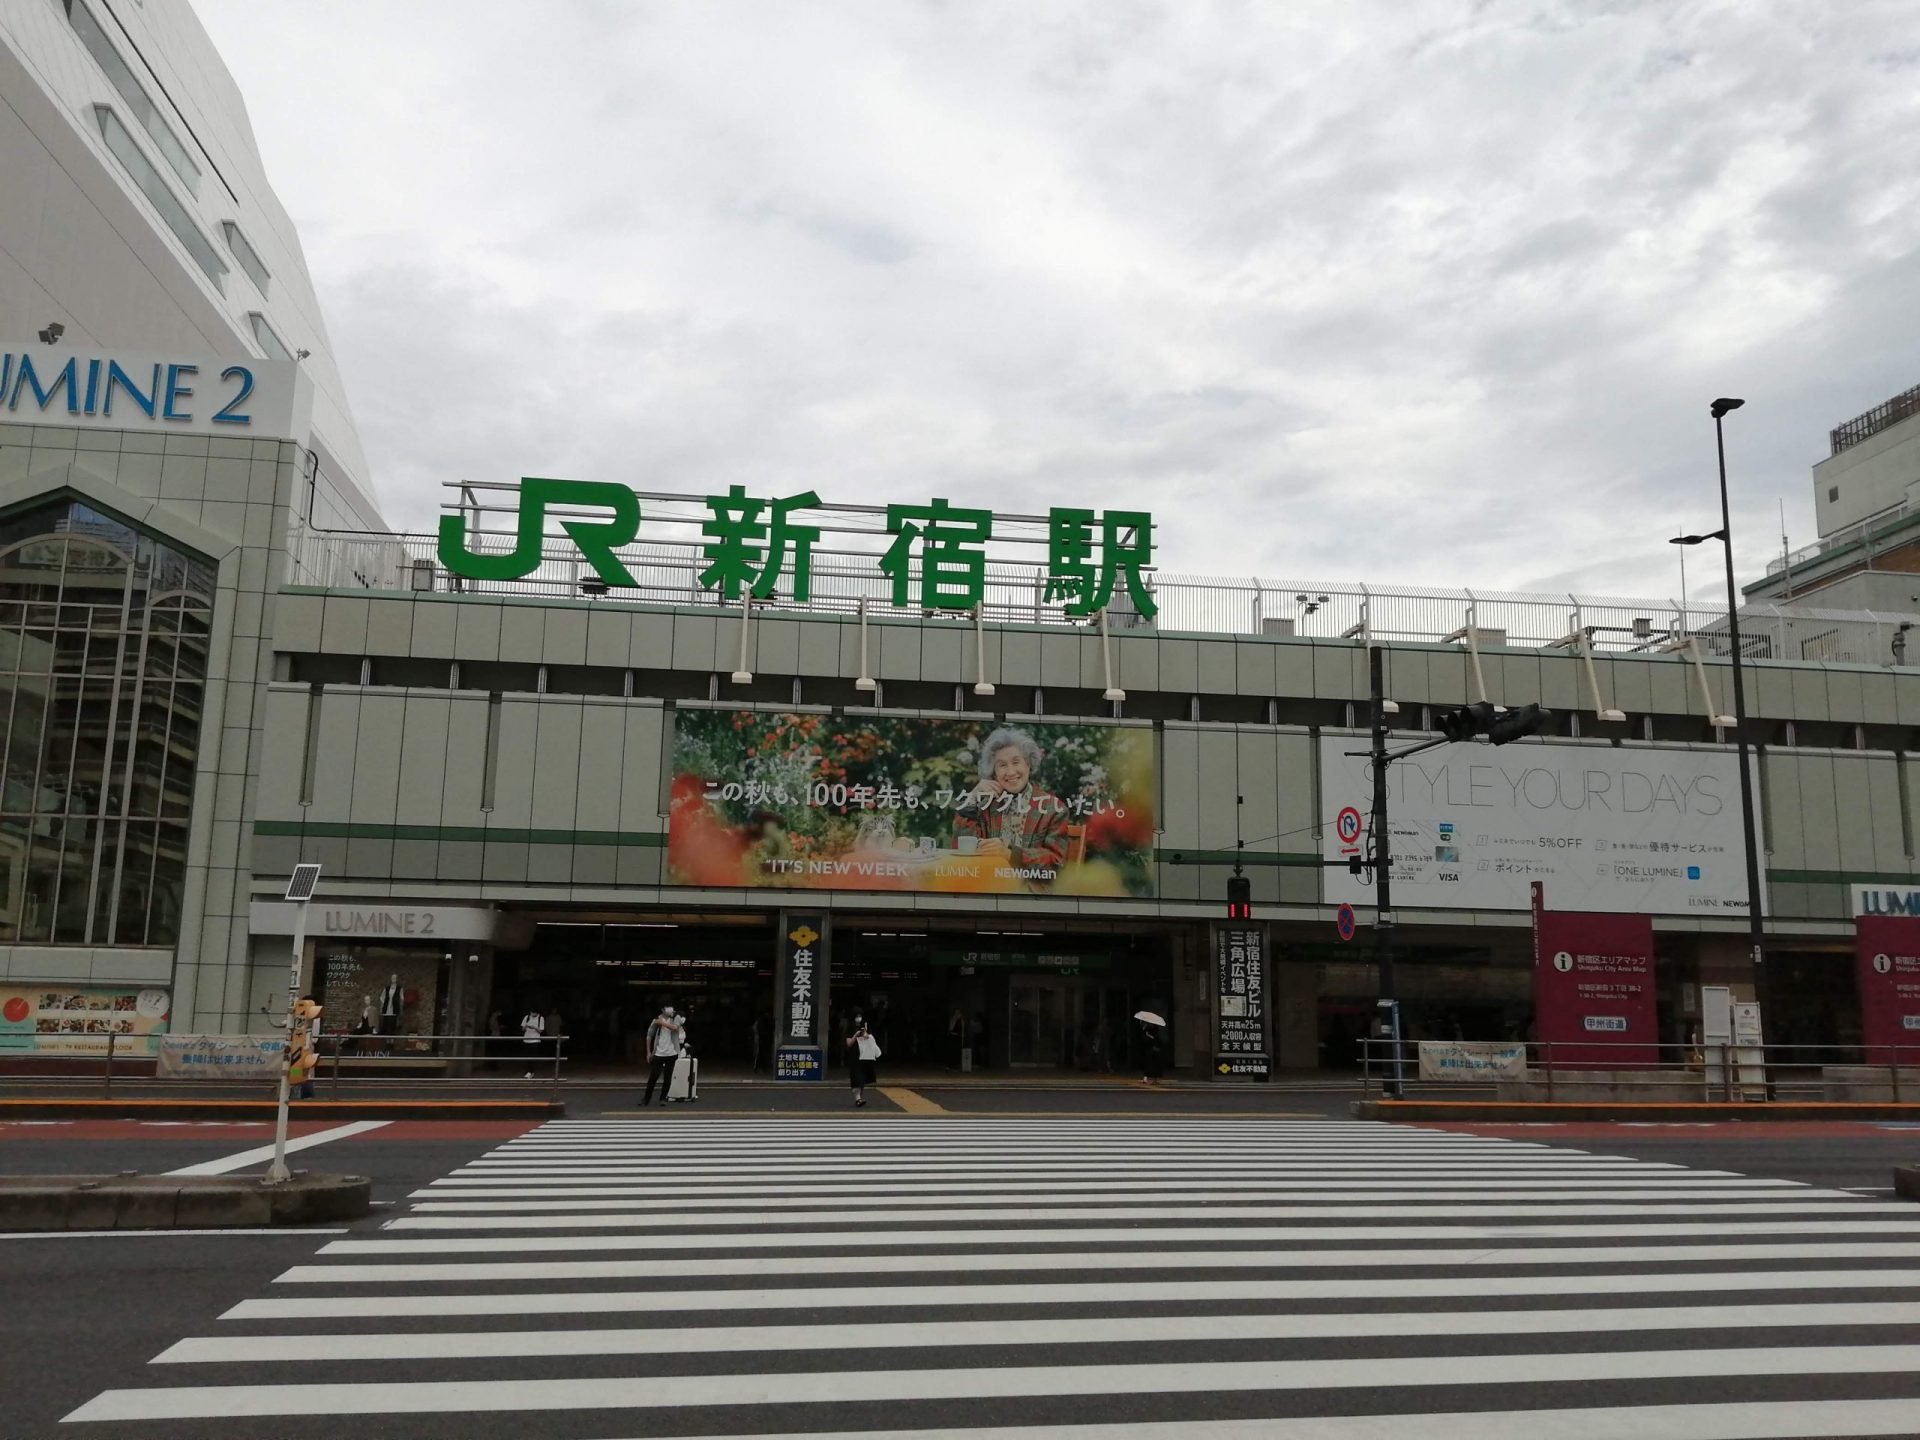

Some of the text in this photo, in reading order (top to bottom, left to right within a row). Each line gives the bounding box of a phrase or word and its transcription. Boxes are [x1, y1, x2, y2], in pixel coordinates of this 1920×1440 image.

[211, 366, 256, 424] 2
[1500, 767, 1613, 811] YOUR
[1622, 771, 1723, 815] DAYS
[1539, 837, 1583, 848] 5%OFF
[857, 861, 908, 877] WEEK
[935, 865, 981, 878] LUMINE
[1439, 873, 1459, 881] VISA
[325, 911, 435, 934] LUMINE 2
[1230, 931, 1246, 994] 三角広場
[1246, 930, 1262, 1018] 新宿住友ビル
[790, 948, 813, 1038] 住友不動産
[1231, 1064, 1268, 1074] 住友不動産
